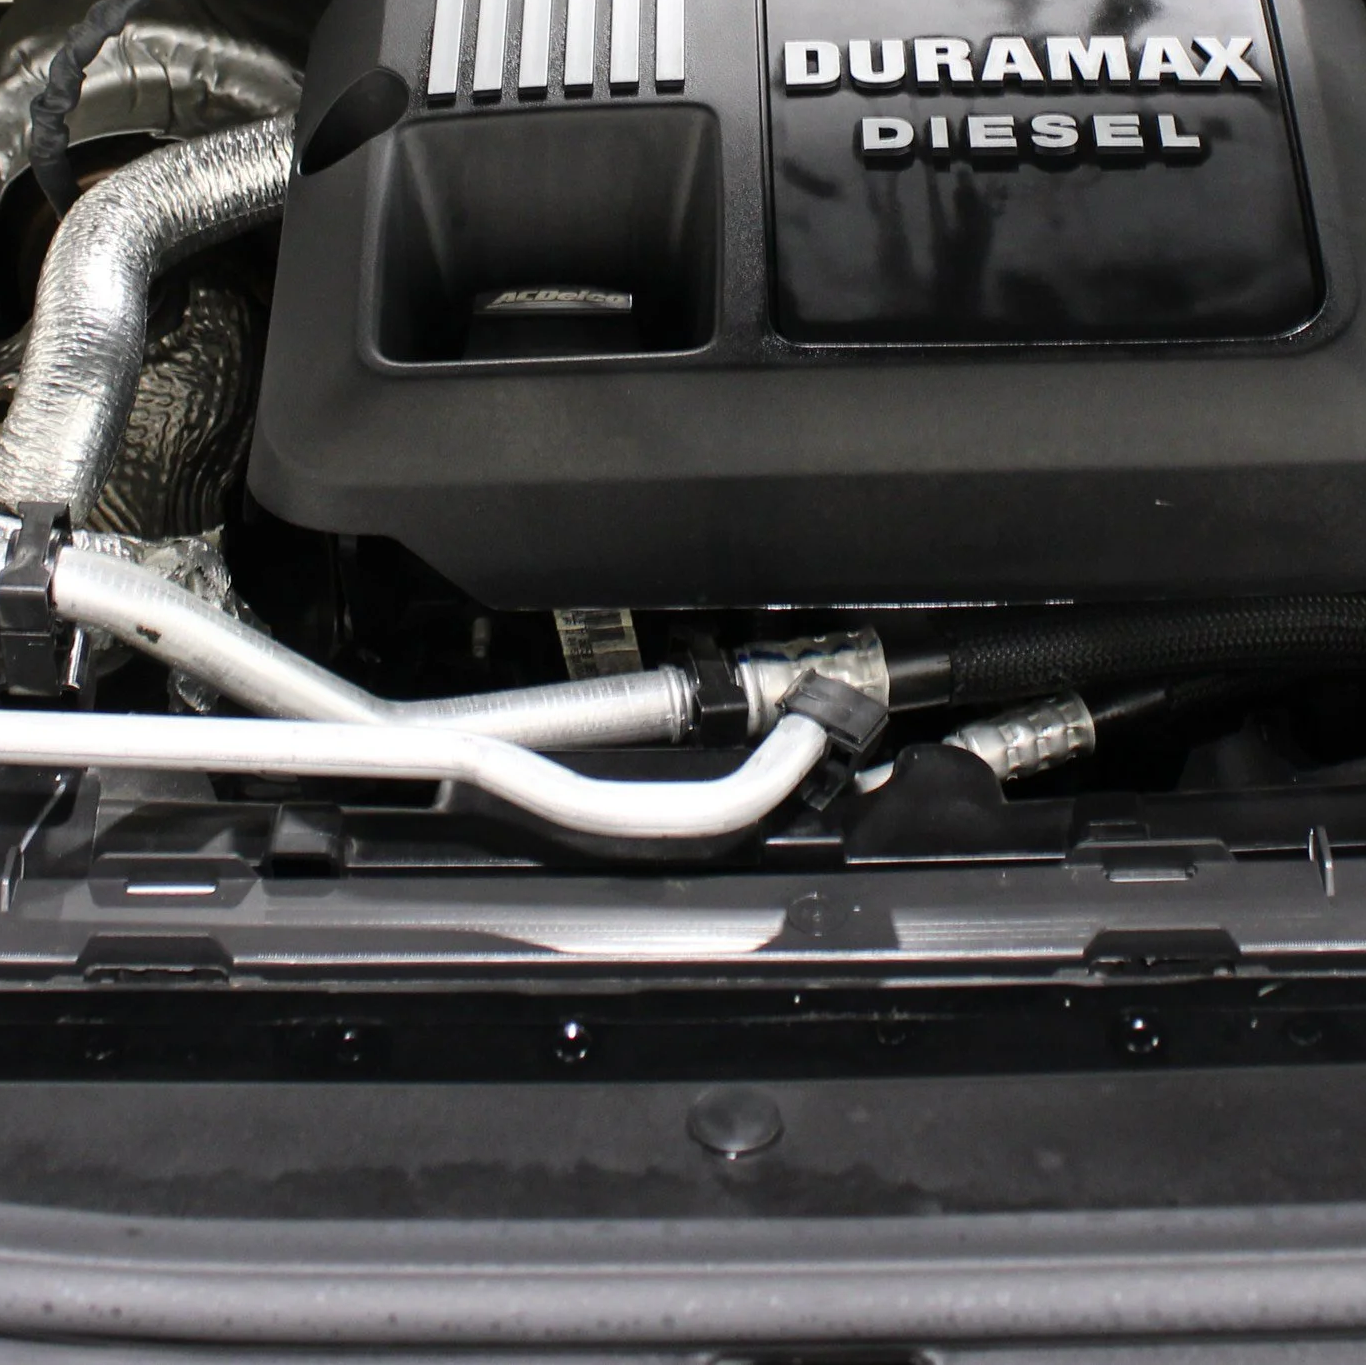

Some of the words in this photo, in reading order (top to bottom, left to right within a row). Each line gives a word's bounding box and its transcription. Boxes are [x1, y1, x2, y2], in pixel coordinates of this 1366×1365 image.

[783, 36, 1263, 94] DURAMAX
[860, 113, 1203, 155] DIESEL
[488, 290, 624, 306] ACDelco
